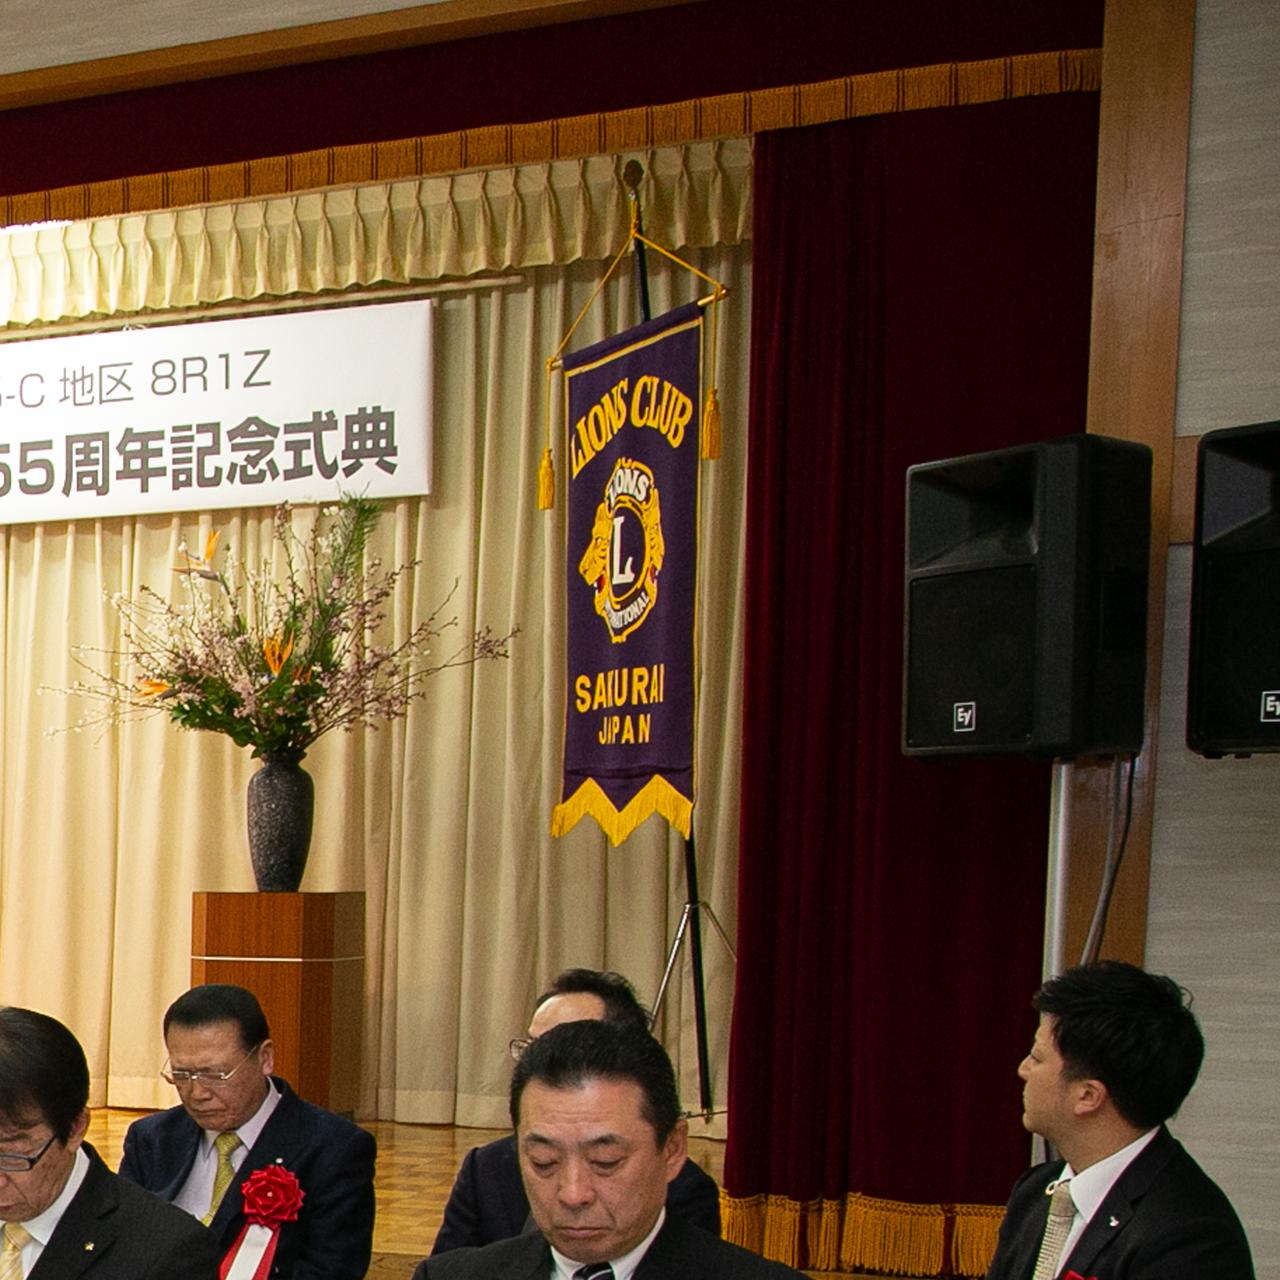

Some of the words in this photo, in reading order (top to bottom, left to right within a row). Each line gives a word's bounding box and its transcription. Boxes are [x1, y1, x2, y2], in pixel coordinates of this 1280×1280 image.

[59, 360, 134, 406] 地区
[151, 349, 272, 397] 8R1Z
[571, 377, 628, 480] LIONS
[630, 375, 693, 448] CLUB
[613, 516, 635, 585] L
